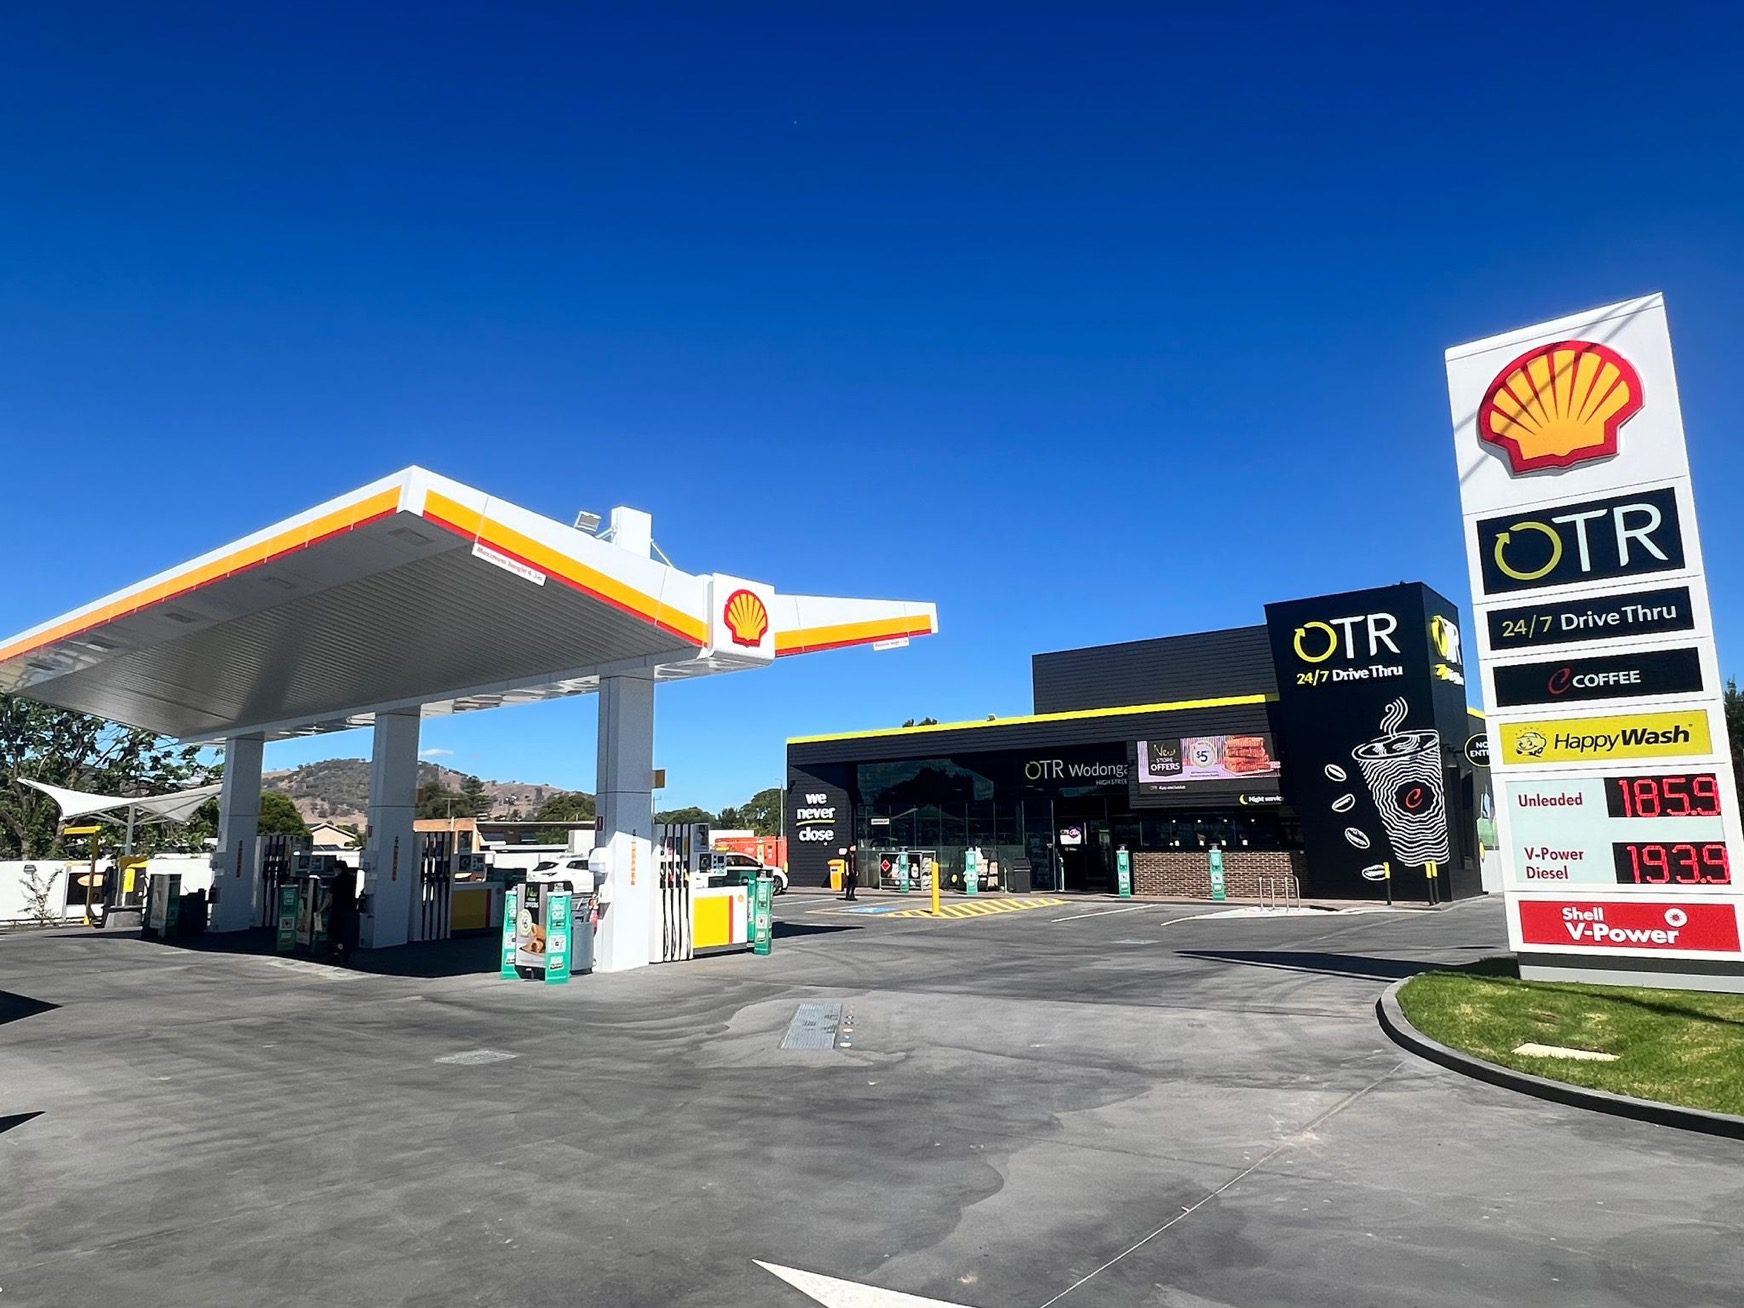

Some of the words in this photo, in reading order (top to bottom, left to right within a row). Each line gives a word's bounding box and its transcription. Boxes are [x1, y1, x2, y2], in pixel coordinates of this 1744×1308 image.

[1494, 503, 1669, 581] OTR
[1502, 615, 1553, 638] 24/7
[1561, 611, 1620, 631] Drive
[1621, 604, 1677, 623] Thru
[1293, 612, 1401, 663] OTR
[1296, 669, 1329, 686] 24/7
[1332, 668, 1369, 682] Drive
[1369, 665, 1404, 678] Thru
[1572, 670, 1641, 689] COFFEE
[1475, 741, 1488, 749] NO
[1196, 750, 1208, 763] $5
[1025, 759, 1064, 780] OTR
[1150, 762, 1180, 772] OFFERS
[805, 793, 827, 804] we
[1518, 792, 1583, 808] Unleaded
[1618, 777, 1722, 817] 185.9
[797, 808, 836, 819] never
[799, 827, 834, 841] close
[1524, 846, 1584, 861] V-Power
[1625, 844, 1732, 884] 193.9
[1526, 865, 1569, 880] Diesel
[1562, 906, 1605, 921] Shell
[1564, 922, 1680, 944] V-Power
